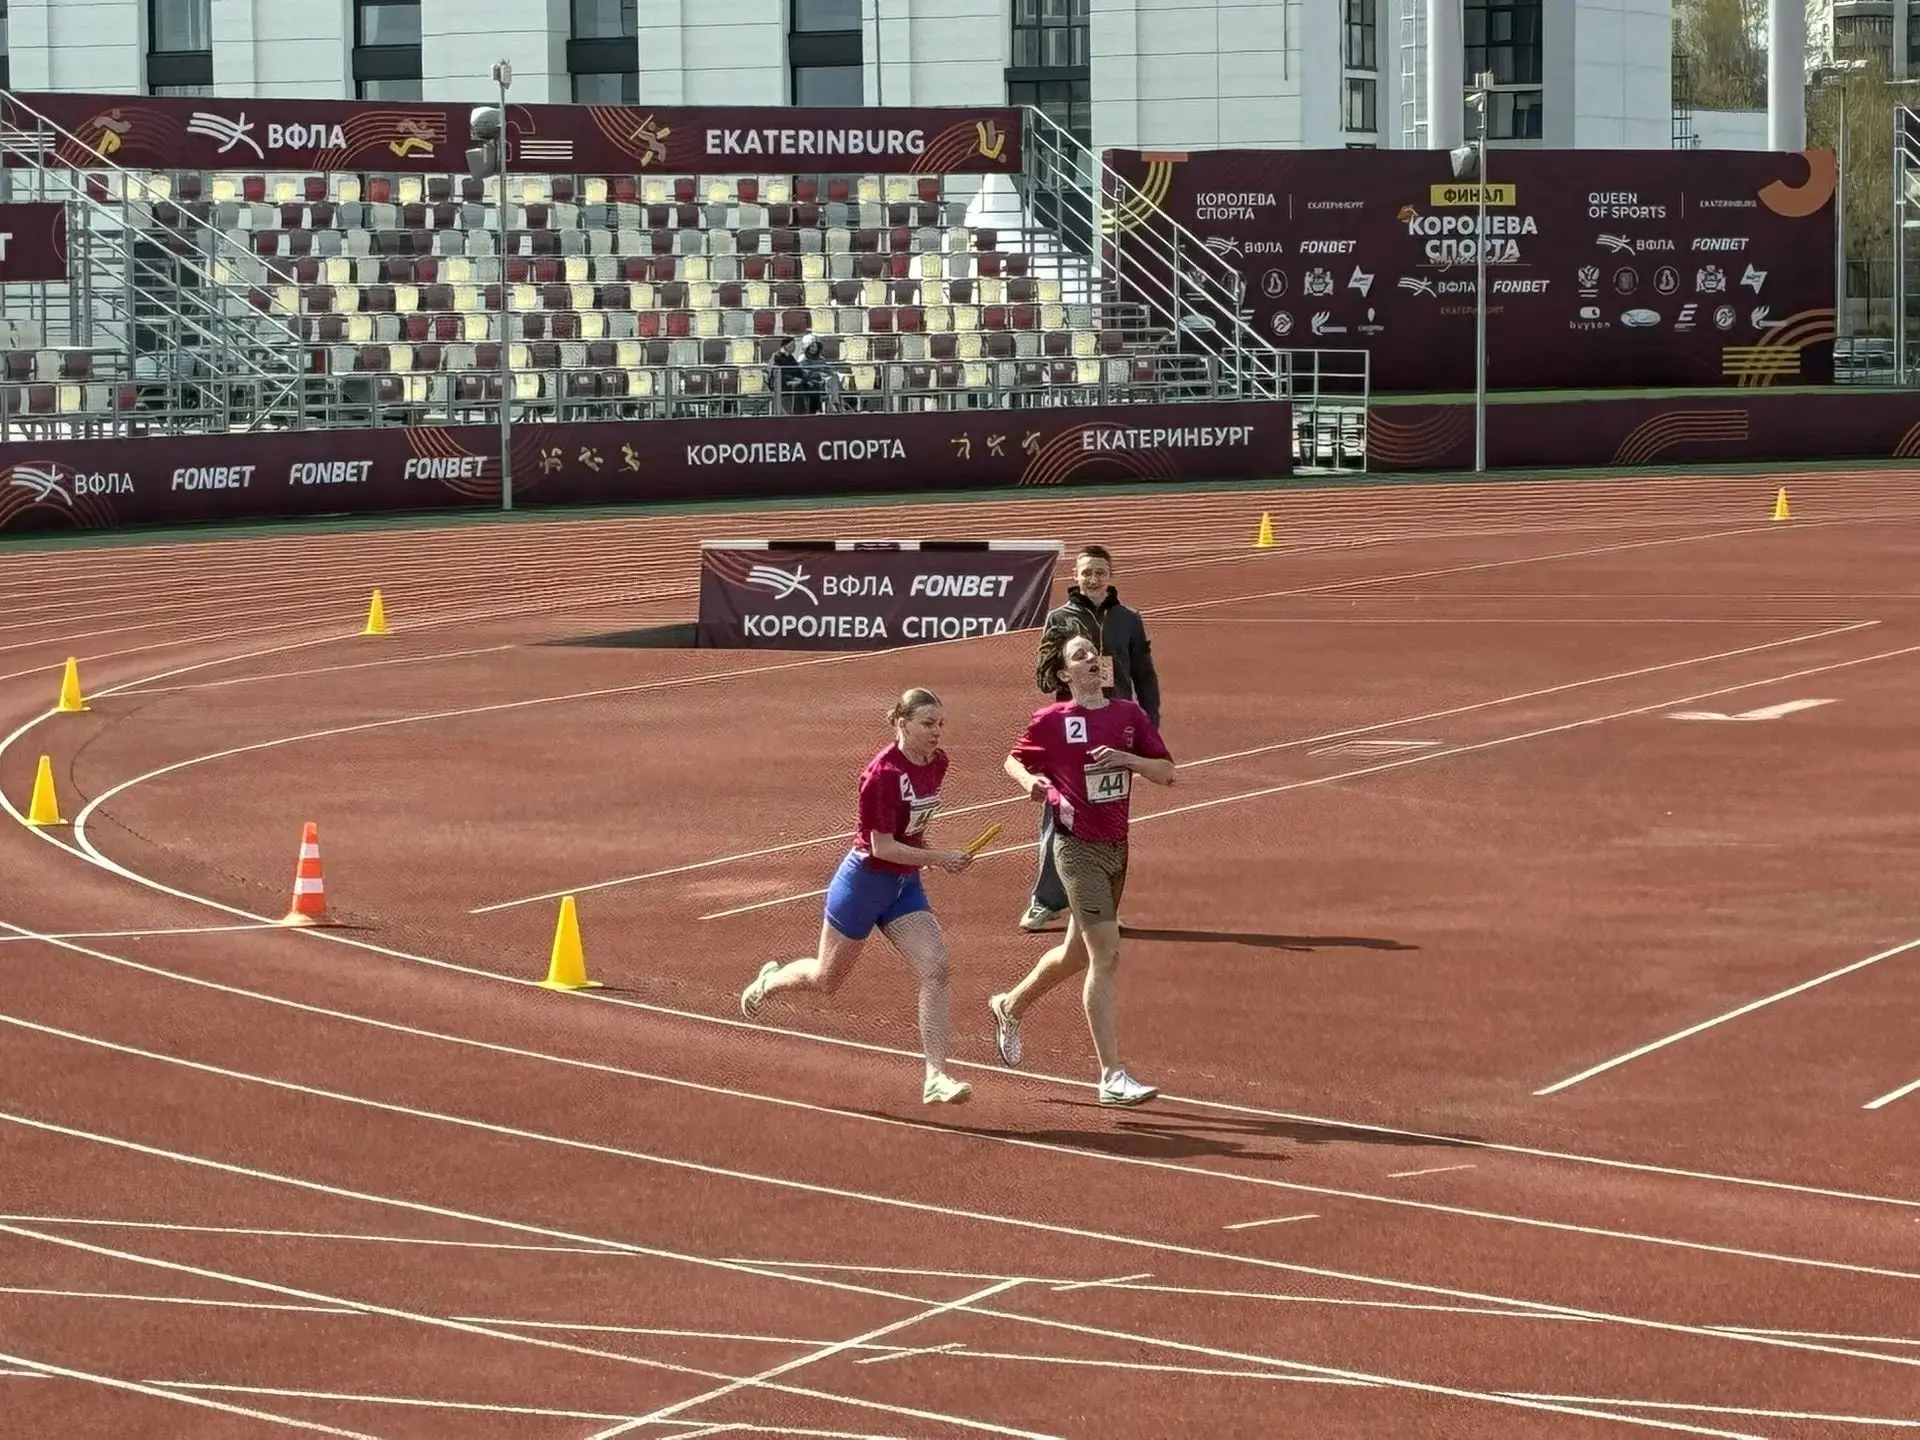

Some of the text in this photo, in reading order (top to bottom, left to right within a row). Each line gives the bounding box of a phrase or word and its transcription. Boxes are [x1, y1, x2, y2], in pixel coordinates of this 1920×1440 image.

[267, 122, 347, 151] ВФЛА
[705, 128, 925, 156] EKATERINBURG
[1196, 193, 1277, 206] КОРОЛЕВА
[1443, 188, 1504, 204] ФИНАЛ
[1588, 192, 1638, 205] QUEEN
[1196, 207, 1255, 220] СПОРТА
[1588, 206, 1666, 219] OF SPORTS
[1408, 216, 1538, 235] КОРОЛЕВА
[1244, 242, 1284, 253] ВФЛА
[1300, 240, 1356, 253] FONBET
[1636, 240, 1675, 250] ВФЛА
[1691, 238, 1749, 250] FONBET
[1438, 281, 1476, 293] ВФЛА
[1492, 280, 1550, 293] FONBET
[1082, 426, 1254, 450] ЕКАТЕРИНБУРГ
[686, 438, 906, 466] КОРОЛЕВА СПОРТА
[172, 465, 255, 490] FONBET
[289, 460, 373, 485] FONBET
[404, 456, 488, 480] FONBET
[74, 474, 135, 495] ВФЛА
[822, 575, 894, 597] ВФЛА
[910, 575, 1014, 597] FONBET
[744, 615, 1007, 639] КОРОЛЕВА СПОРТА
[1069, 721, 1082, 739] 2
[903, 778, 913, 798] 2
[1099, 774, 1124, 796] 44
